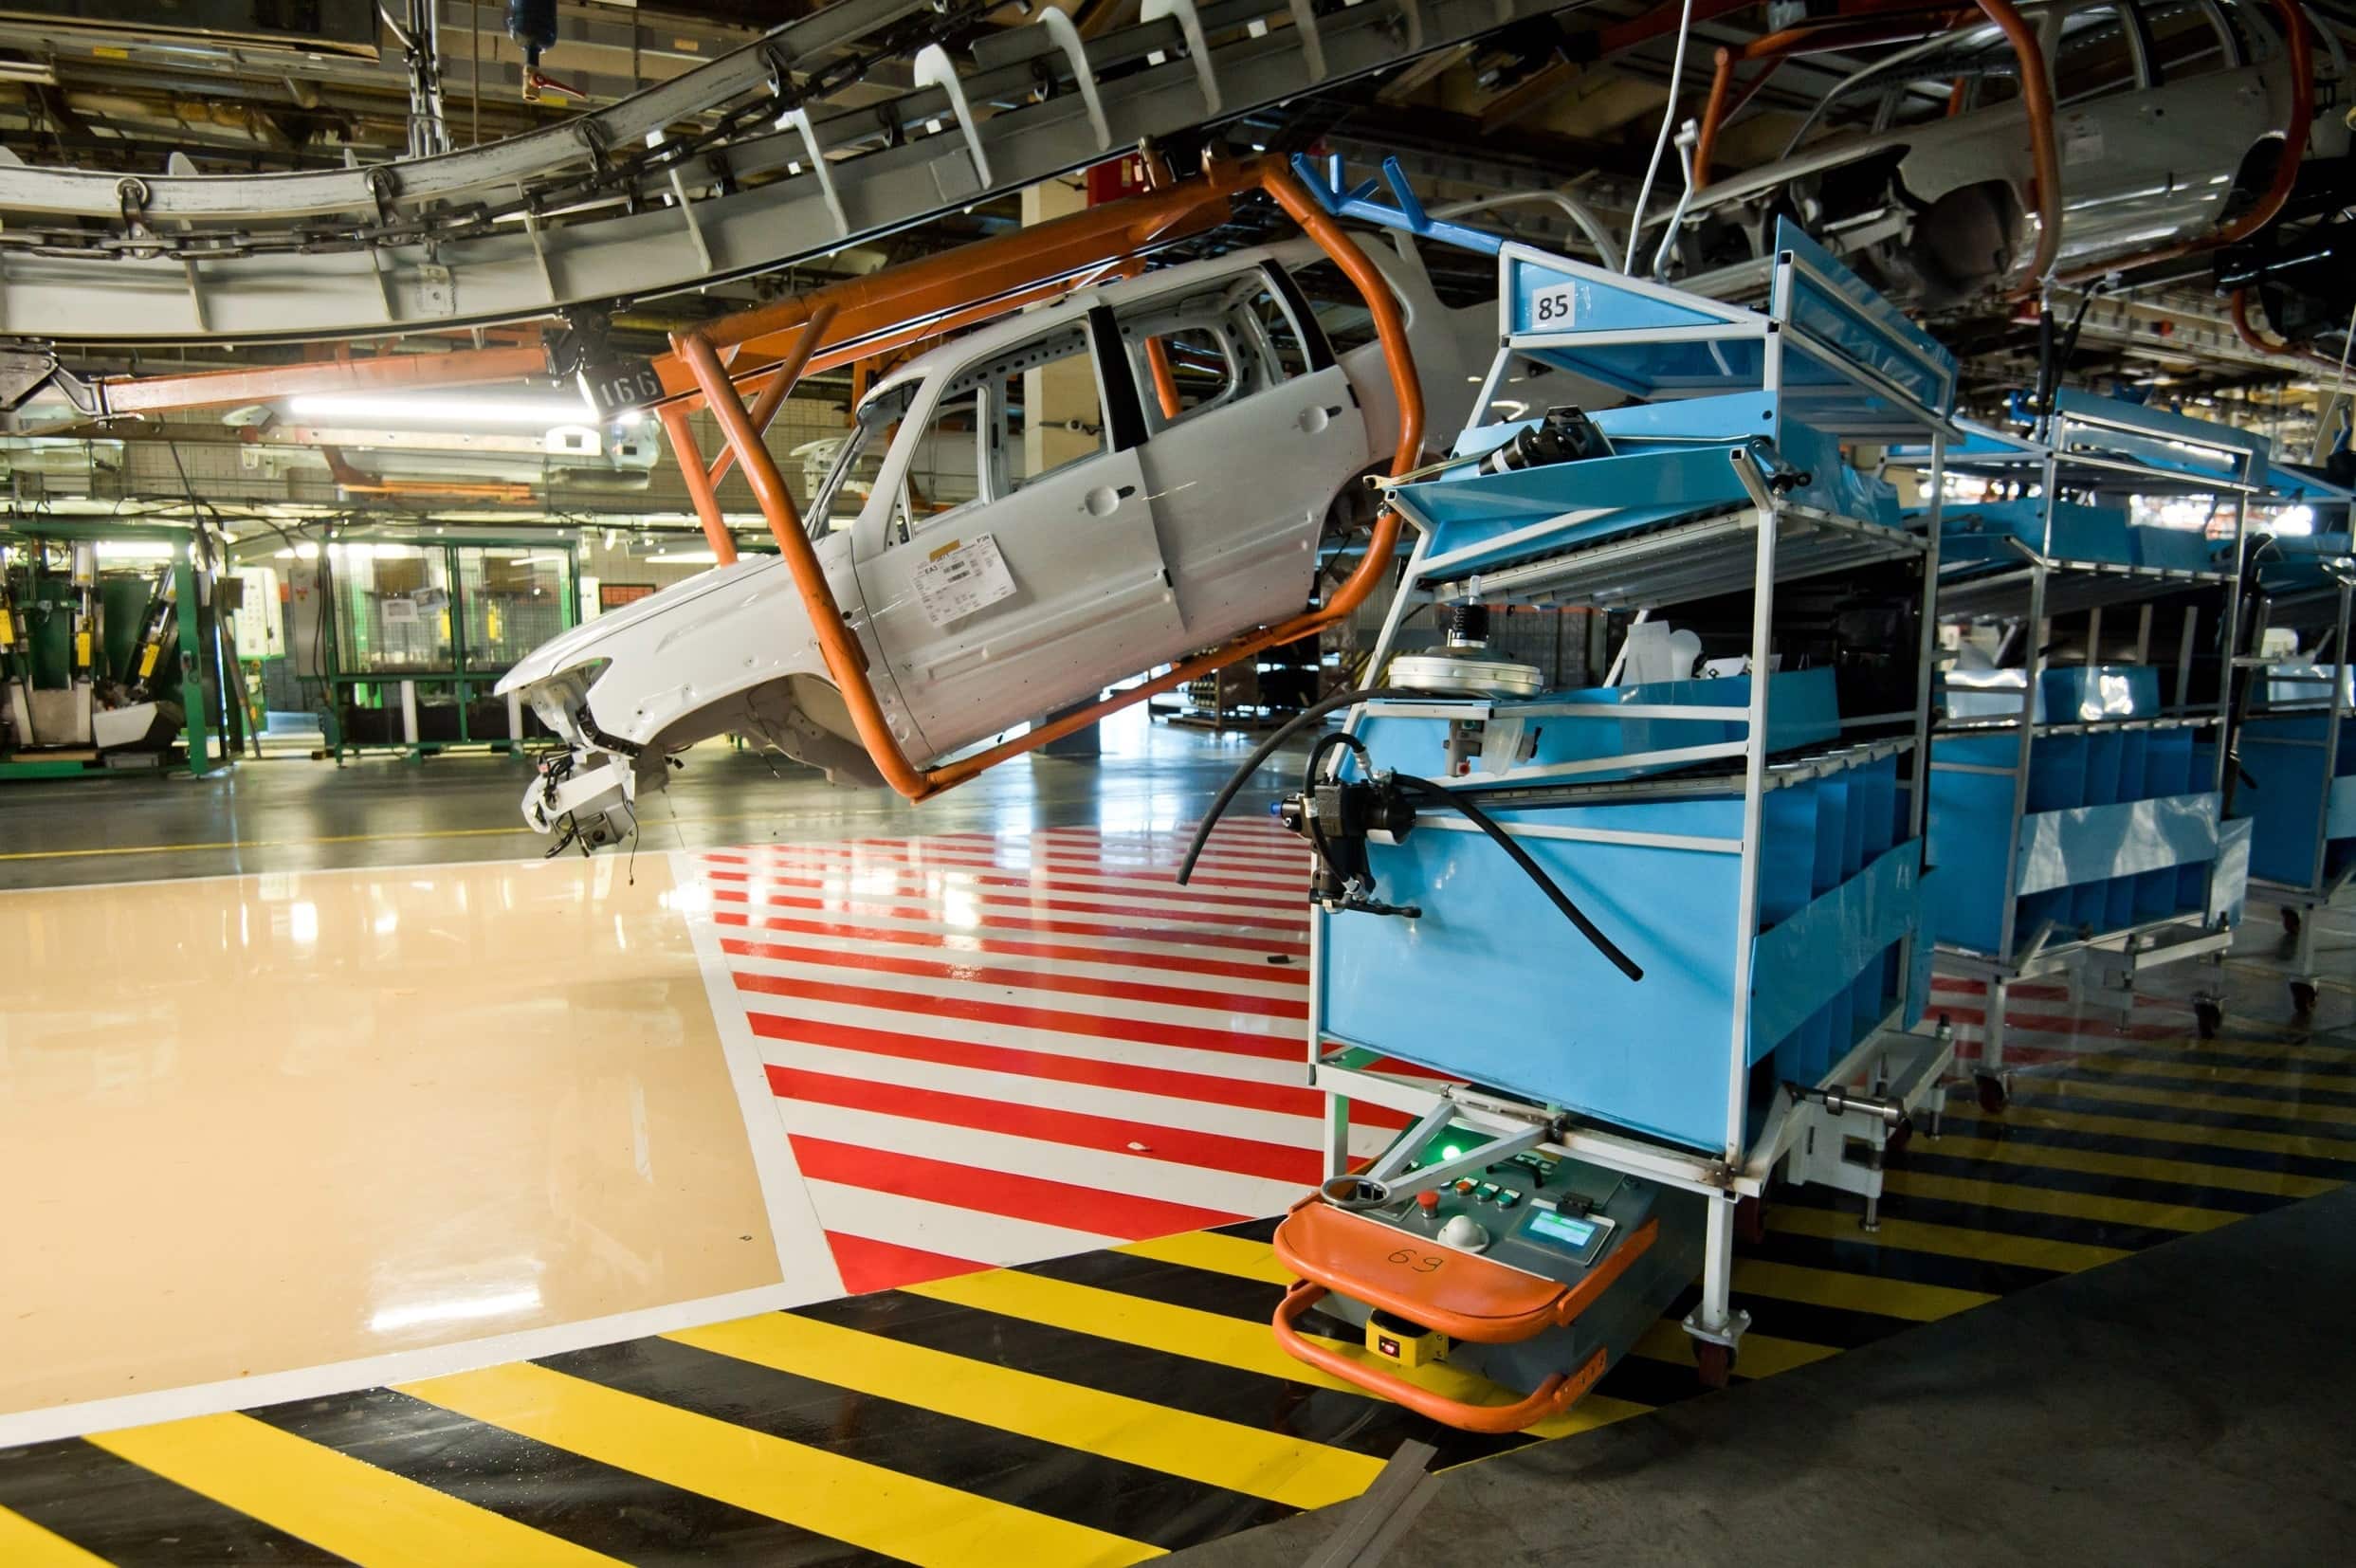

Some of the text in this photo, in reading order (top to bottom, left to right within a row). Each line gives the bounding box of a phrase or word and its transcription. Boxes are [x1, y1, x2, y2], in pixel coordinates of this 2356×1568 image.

[1539, 294, 1568, 320] 85
[600, 371, 658, 407] 166
[1388, 1249, 1444, 1272] 69
